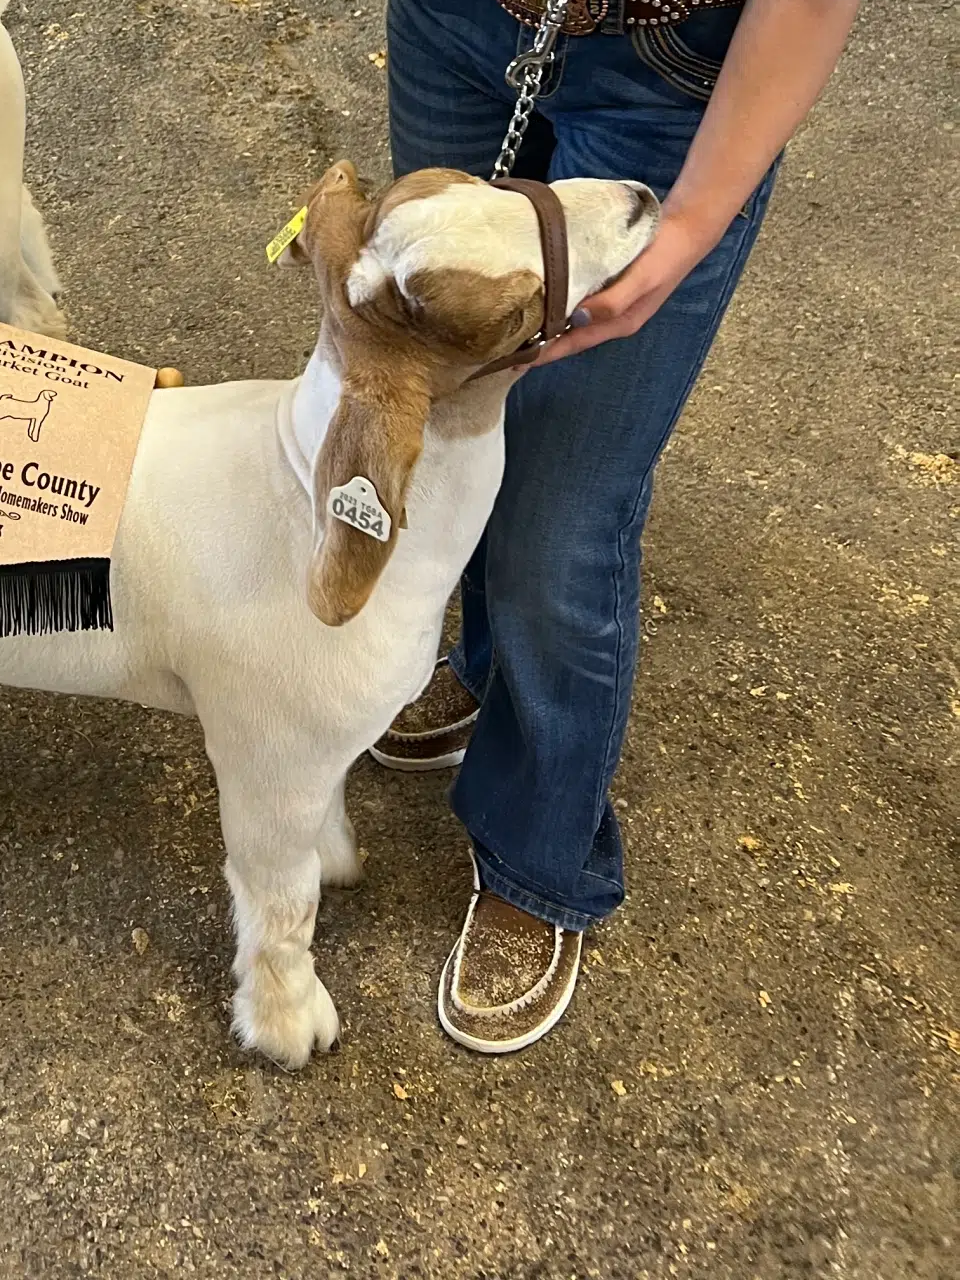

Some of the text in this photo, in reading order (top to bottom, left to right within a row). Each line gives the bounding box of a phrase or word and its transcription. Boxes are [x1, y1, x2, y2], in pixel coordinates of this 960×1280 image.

[45, 371, 89, 389] Goat
[21, 462, 101, 507] County
[60, 503, 89, 526] Show
[332, 498, 384, 537] 0454
